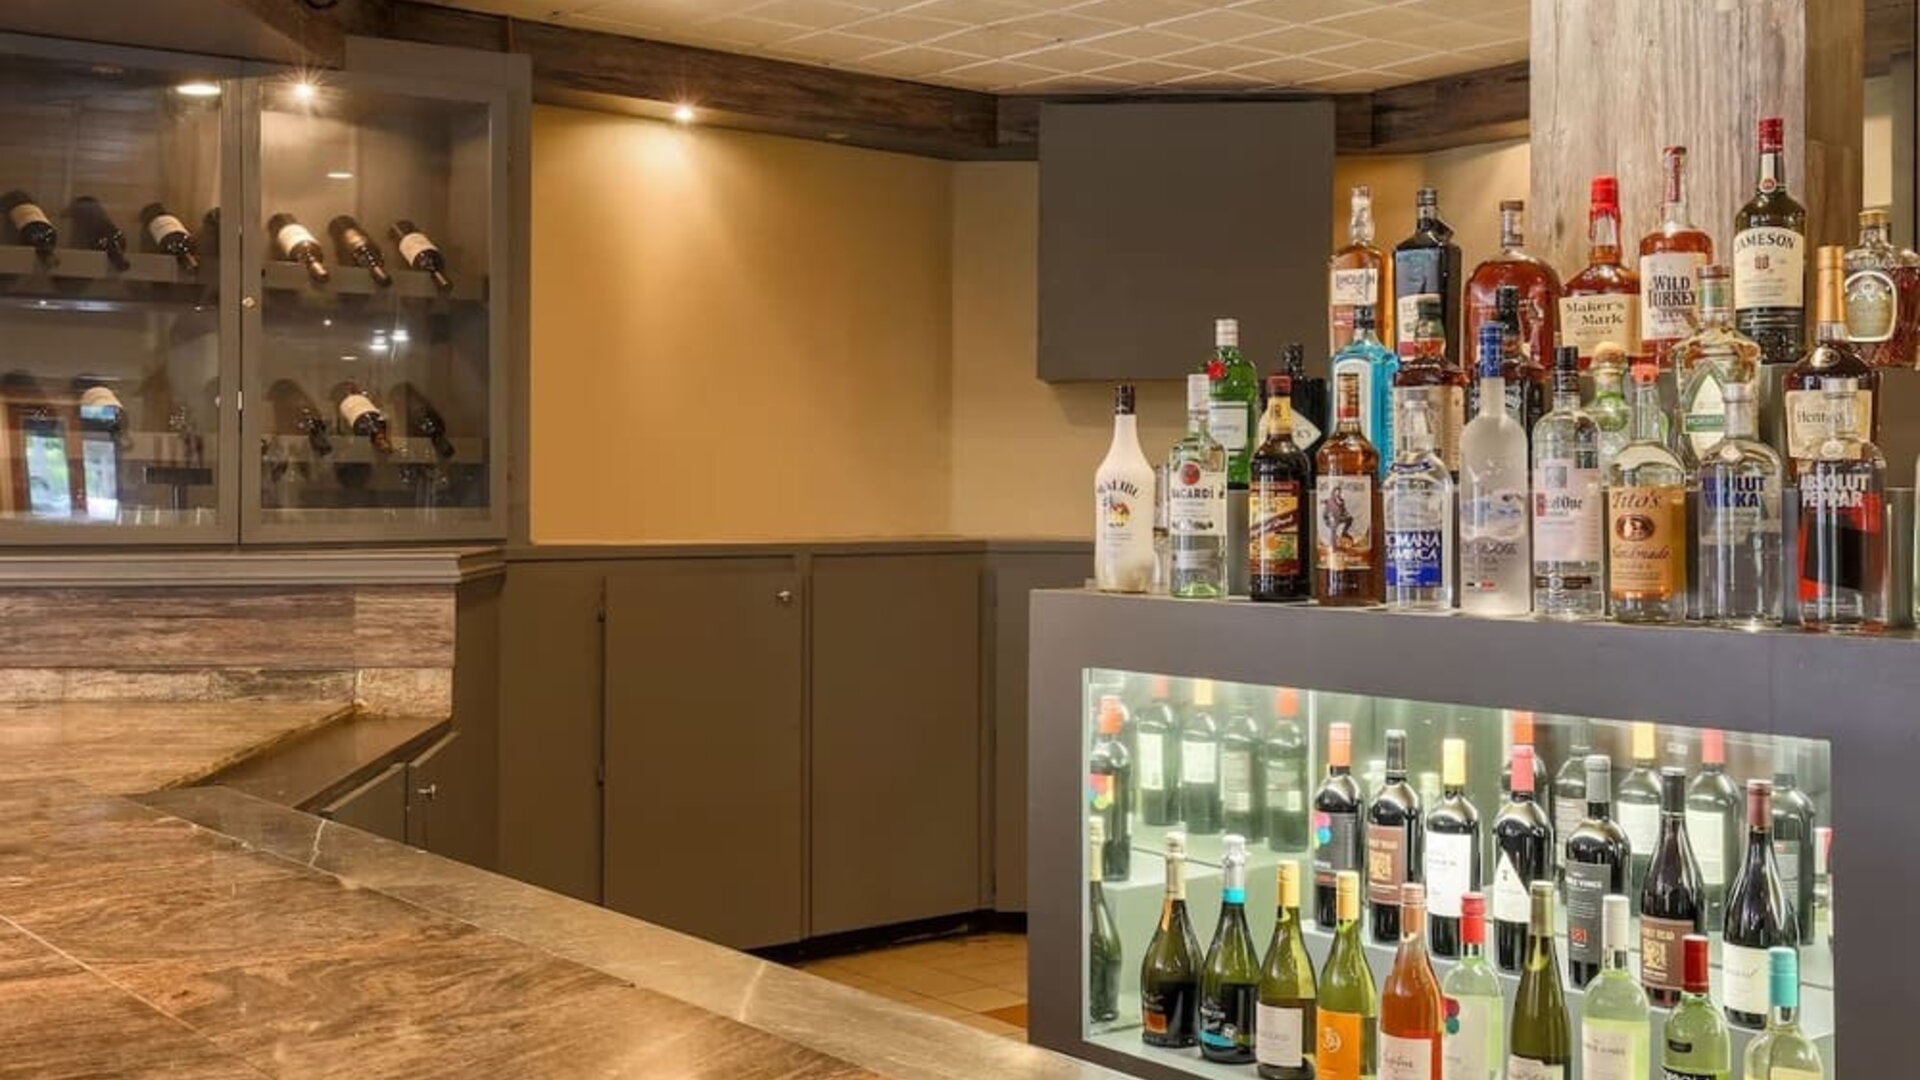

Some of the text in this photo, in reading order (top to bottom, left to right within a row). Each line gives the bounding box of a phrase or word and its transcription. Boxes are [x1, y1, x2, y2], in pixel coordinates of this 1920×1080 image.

[1736, 231, 1794, 253] JAMESON
[1652, 275, 1691, 292] WILD
[1647, 290, 1696, 308] TURKEY
[1580, 314, 1624, 326] Mark
